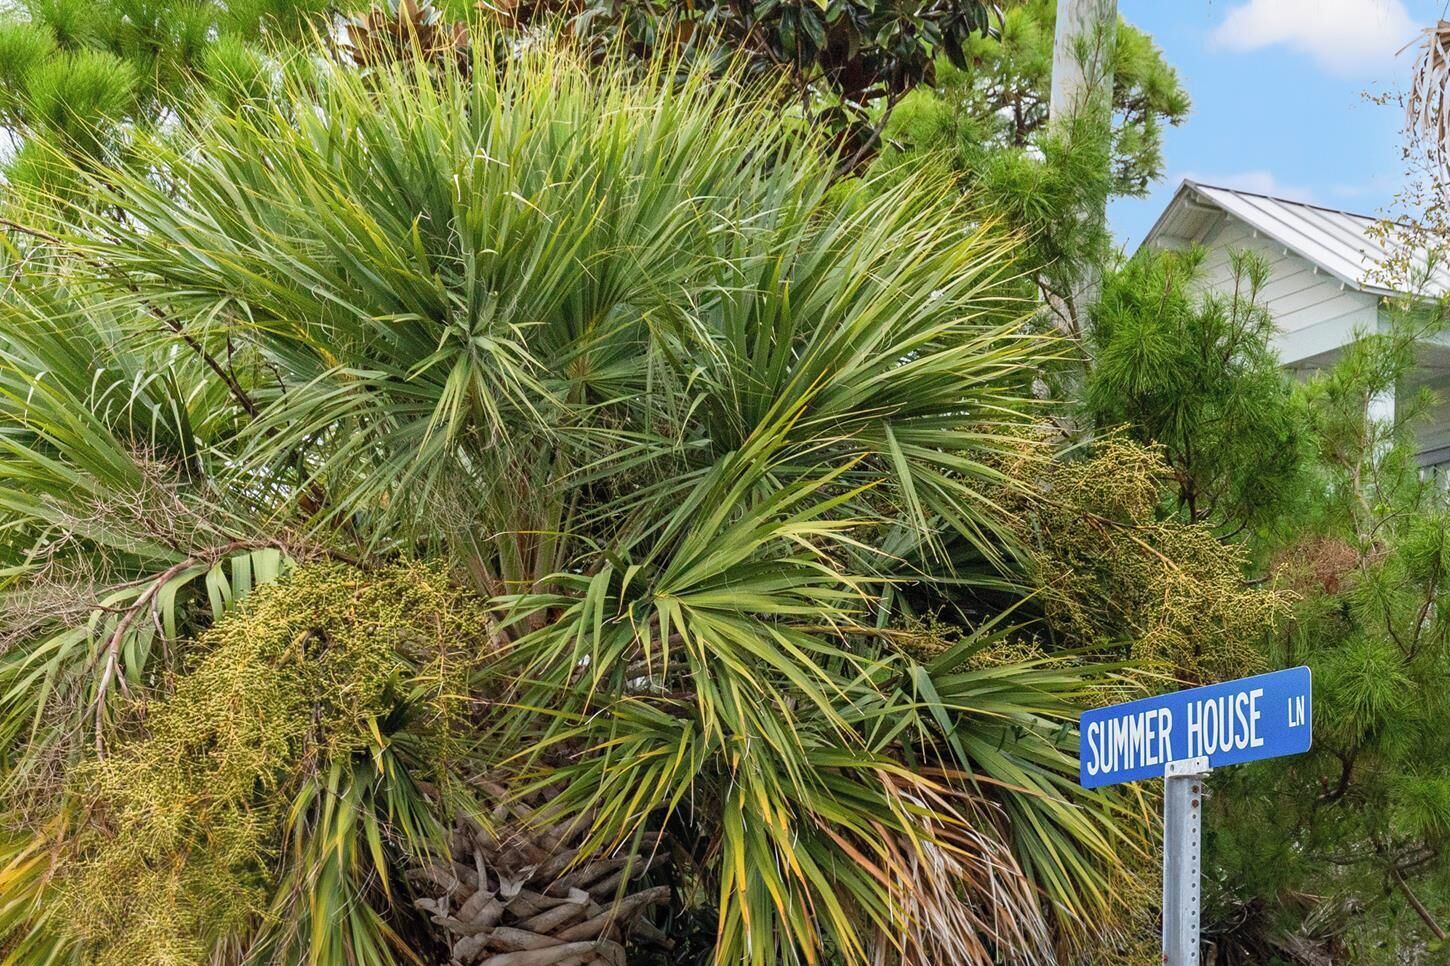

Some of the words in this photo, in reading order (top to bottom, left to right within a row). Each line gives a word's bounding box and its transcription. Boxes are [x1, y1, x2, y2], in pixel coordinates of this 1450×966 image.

[1087, 708, 1173, 776] SUMMER
[1187, 688, 1264, 758] HOUSE
[1288, 695, 1305, 728] LN
